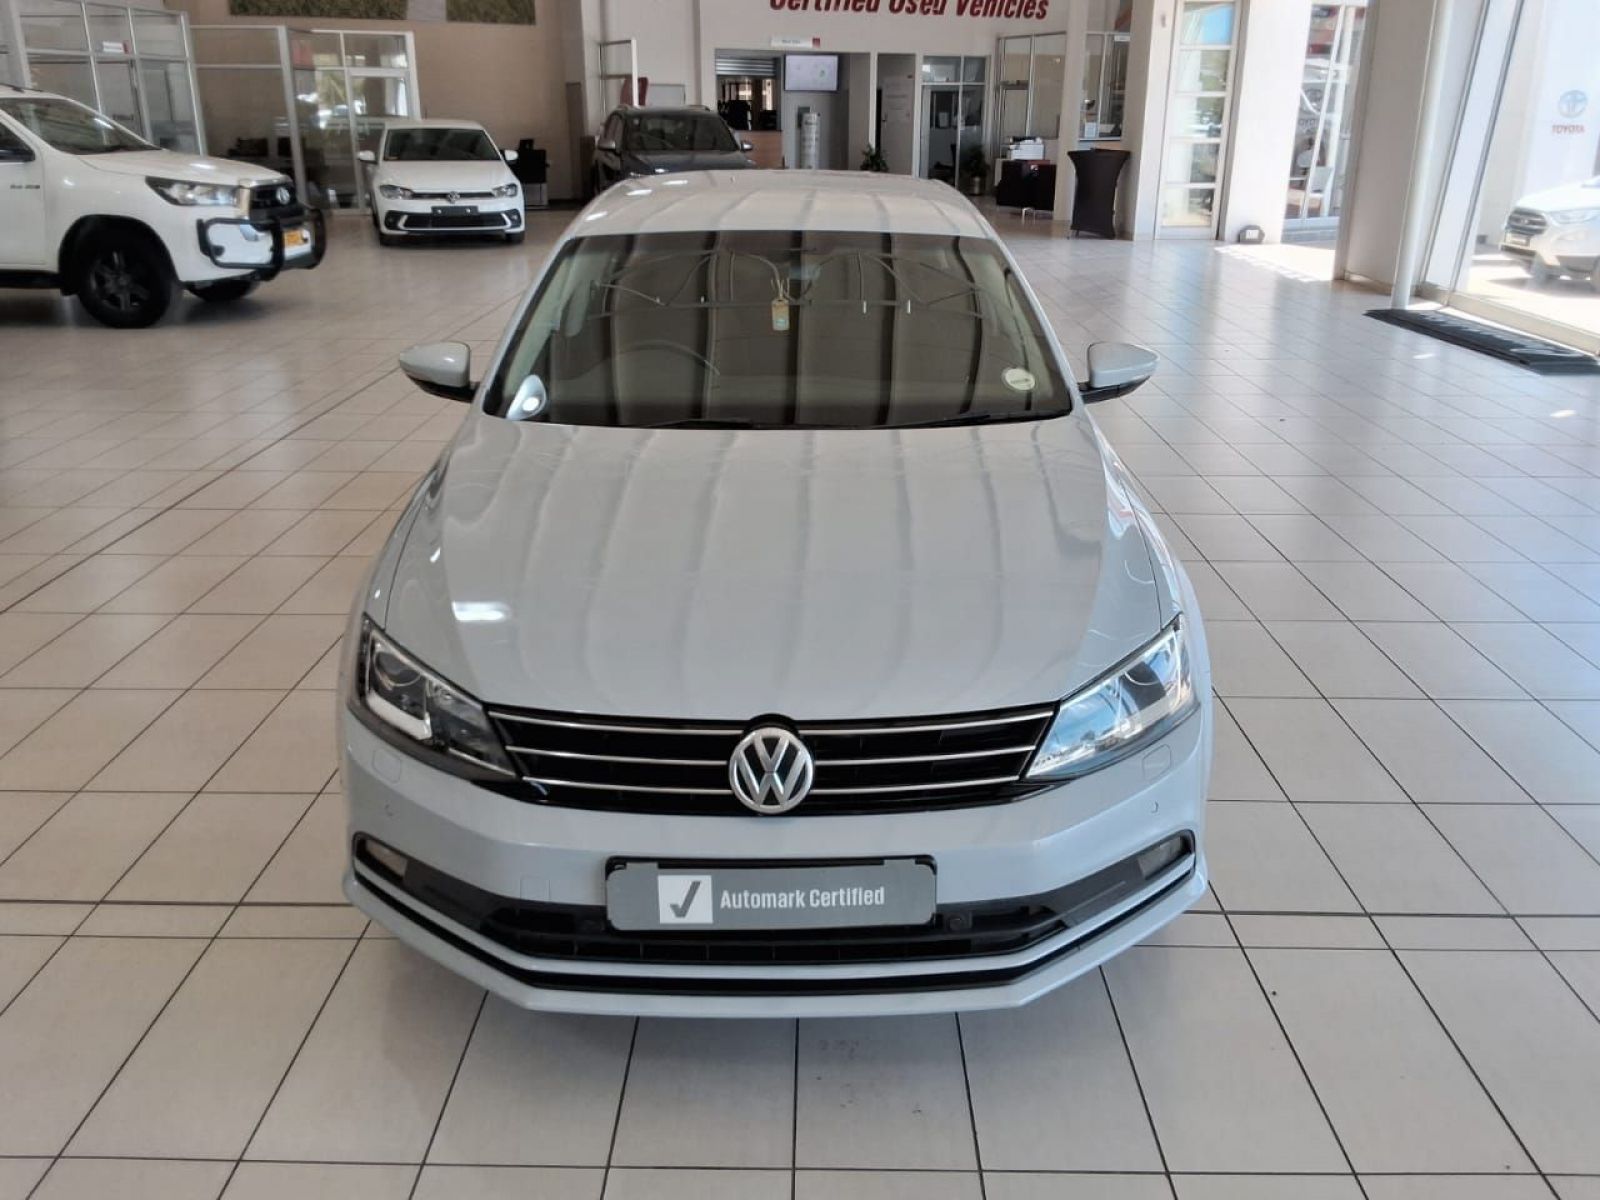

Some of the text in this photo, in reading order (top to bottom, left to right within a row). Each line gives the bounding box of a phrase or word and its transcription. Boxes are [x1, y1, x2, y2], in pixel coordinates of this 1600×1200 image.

[956, 0, 1049, 19] Vehicles
[720, 886, 886, 909] Automark Certified
